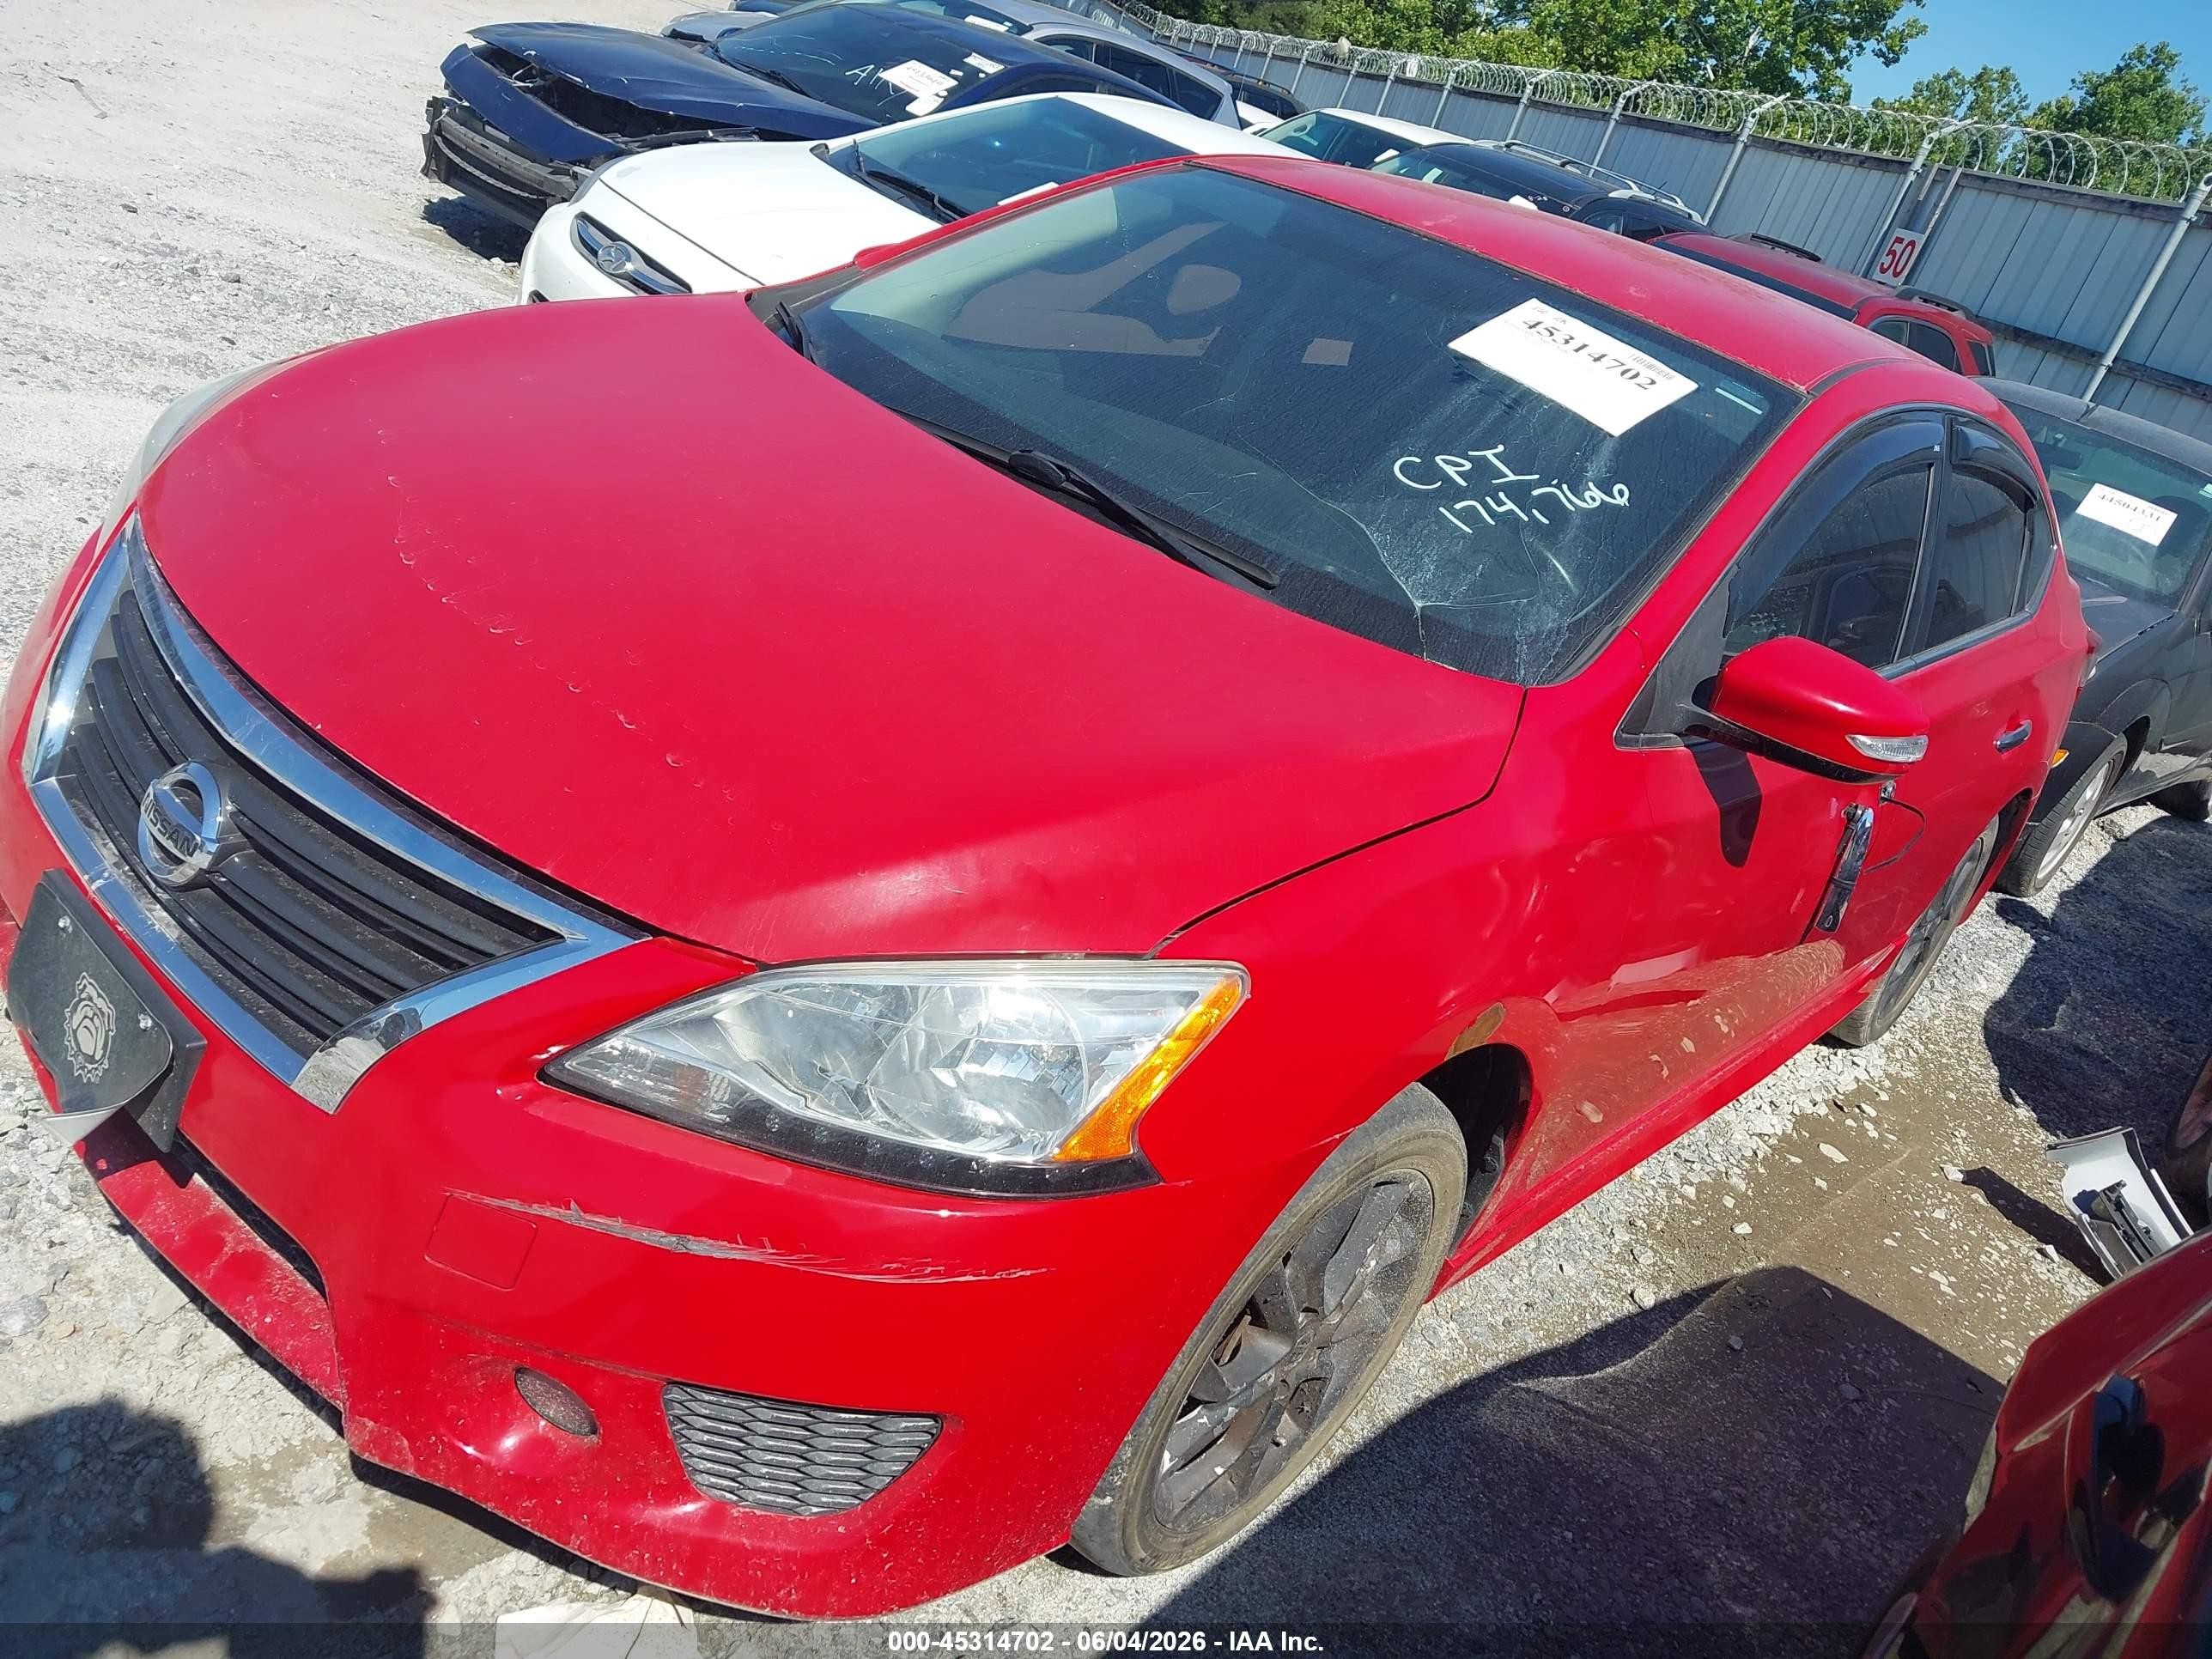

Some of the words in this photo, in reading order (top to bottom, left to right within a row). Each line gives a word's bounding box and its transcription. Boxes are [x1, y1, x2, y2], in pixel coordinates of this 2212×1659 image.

[1879, 236, 1916, 277] 50
[1522, 320, 1656, 390] 45314702
[142, 791, 200, 858] NISSAN
